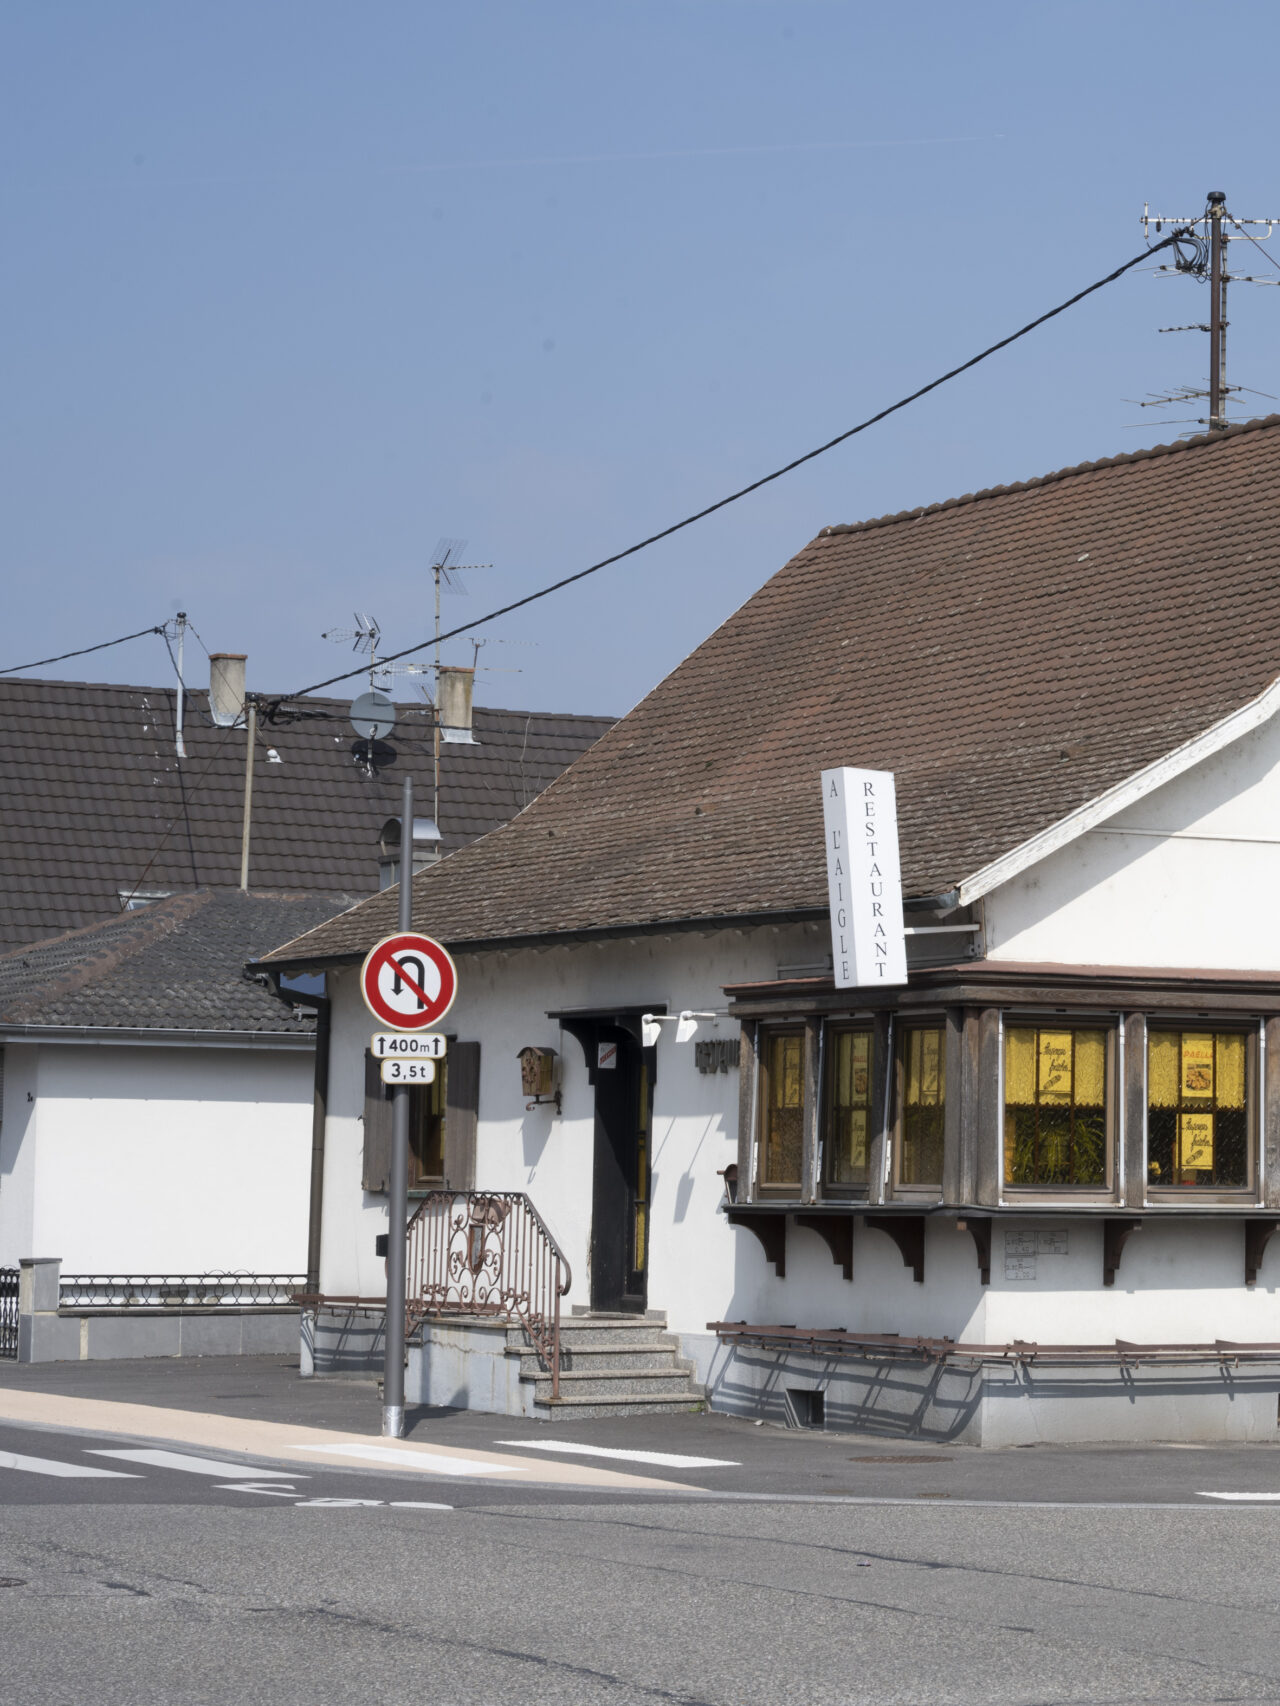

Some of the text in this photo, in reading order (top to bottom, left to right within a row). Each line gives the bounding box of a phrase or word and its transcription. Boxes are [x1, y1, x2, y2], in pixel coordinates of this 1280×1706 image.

[829, 779, 850, 980] A L'AIGLE
[863, 782, 887, 978] RESTAURANT
